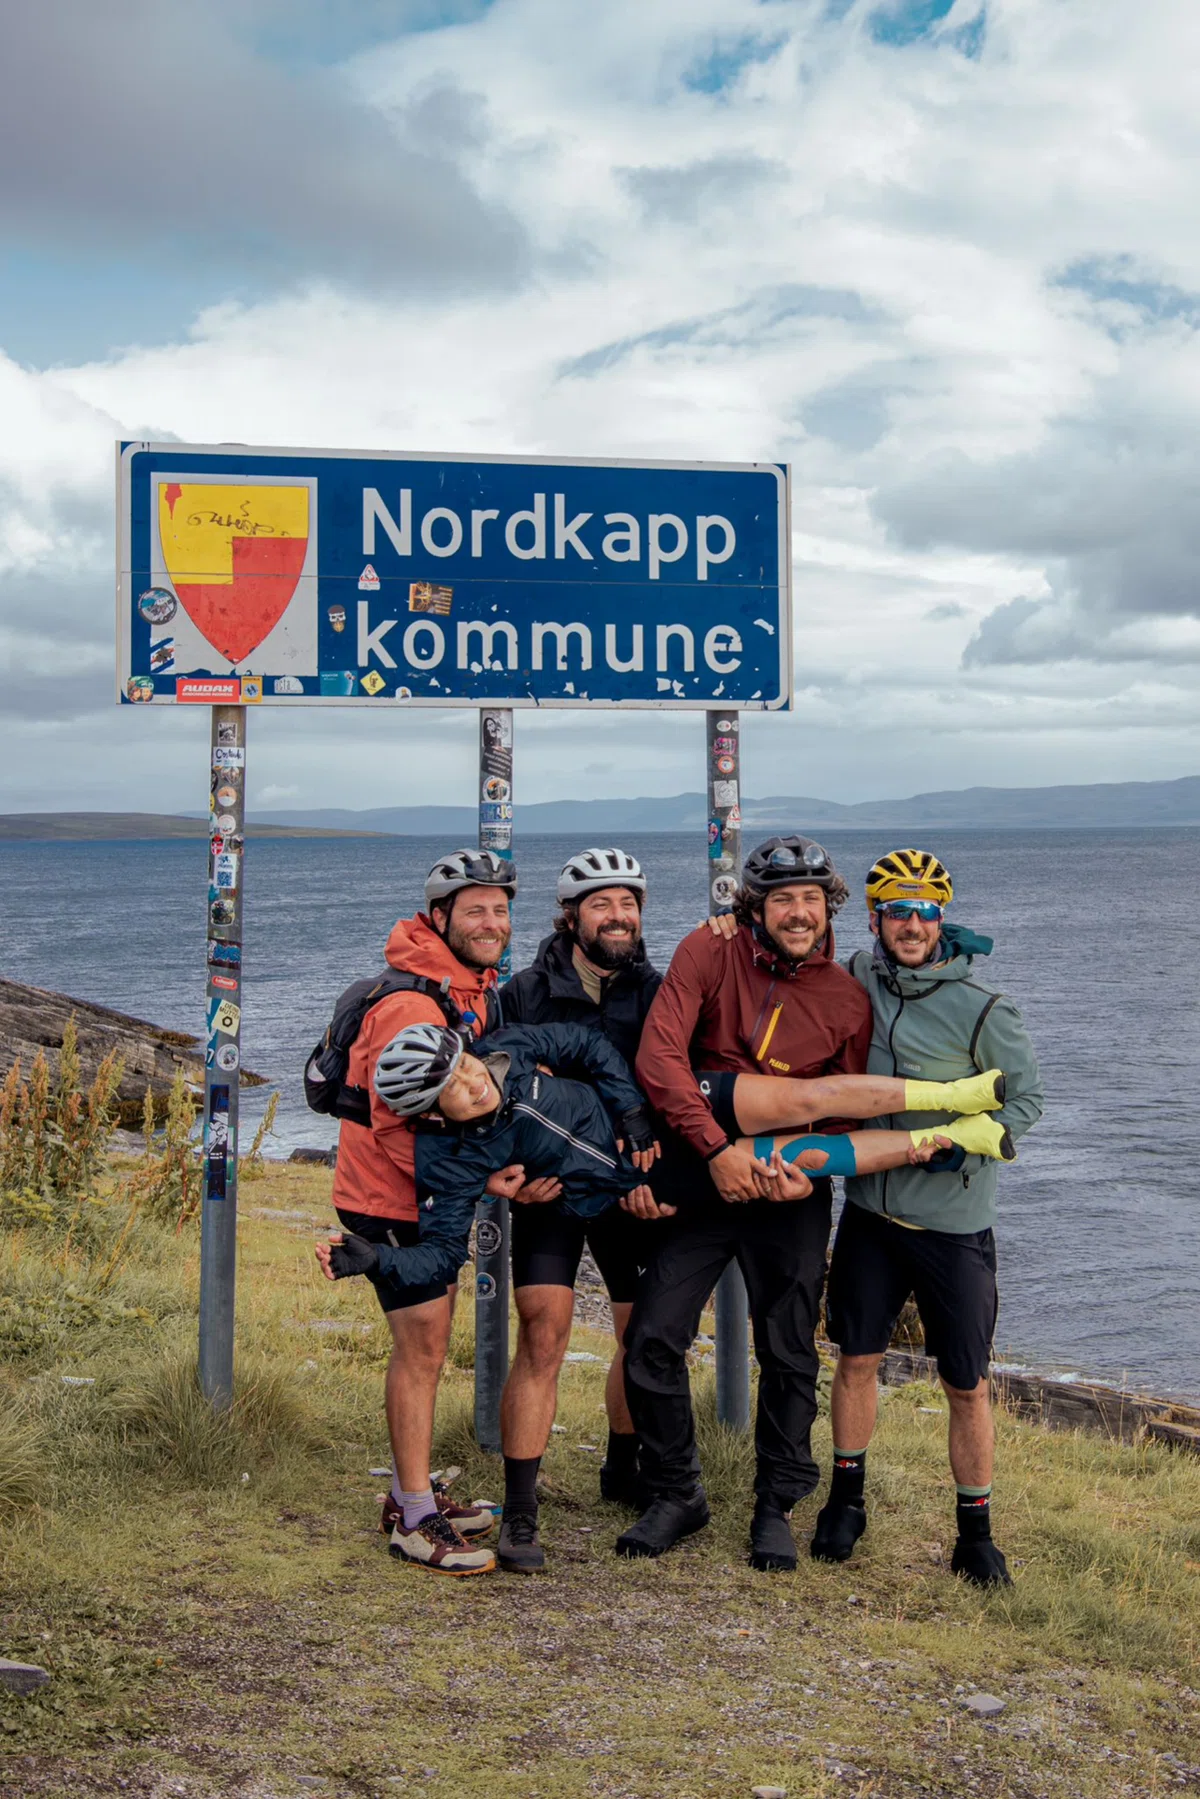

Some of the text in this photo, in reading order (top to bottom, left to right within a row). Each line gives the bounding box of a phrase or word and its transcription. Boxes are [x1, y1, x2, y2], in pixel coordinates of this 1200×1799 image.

[362, 487, 737, 581] Nordkapp
[356, 600, 743, 674] kommune
[182, 684, 234, 692] AUDAX
